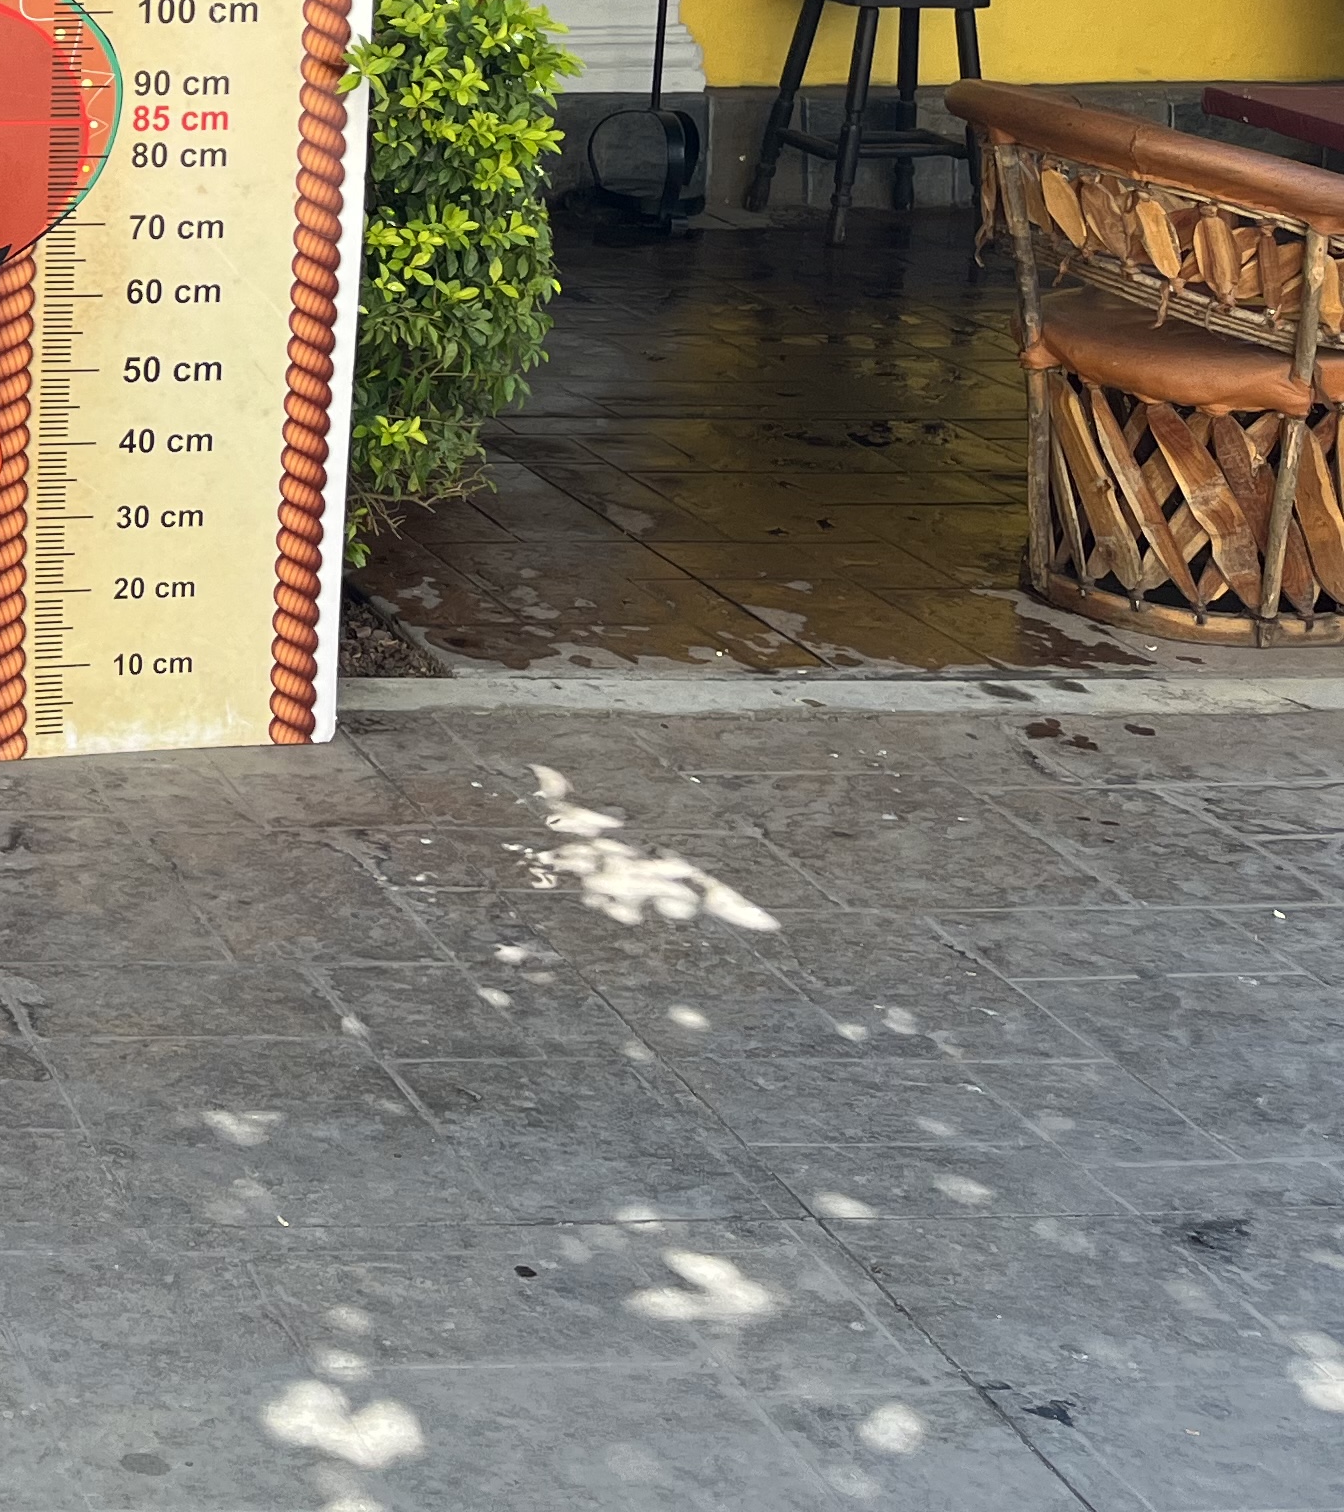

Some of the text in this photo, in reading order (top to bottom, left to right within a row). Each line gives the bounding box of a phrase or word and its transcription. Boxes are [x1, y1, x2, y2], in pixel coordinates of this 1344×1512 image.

[208, 1, 258, 24] cm
[134, 69, 230, 97] 90 cm
[132, 105, 229, 132] 85 cm
[131, 141, 227, 169] 80 cm
[129, 213, 224, 240] 70 cm
[126, 278, 221, 305] 60 cm
[122, 355, 222, 384] 50 cm
[118, 428, 213, 454] 40 cm
[116, 504, 204, 530] 30 cm
[113, 576, 195, 600] 20 cm
[113, 652, 193, 676] 10 cm
